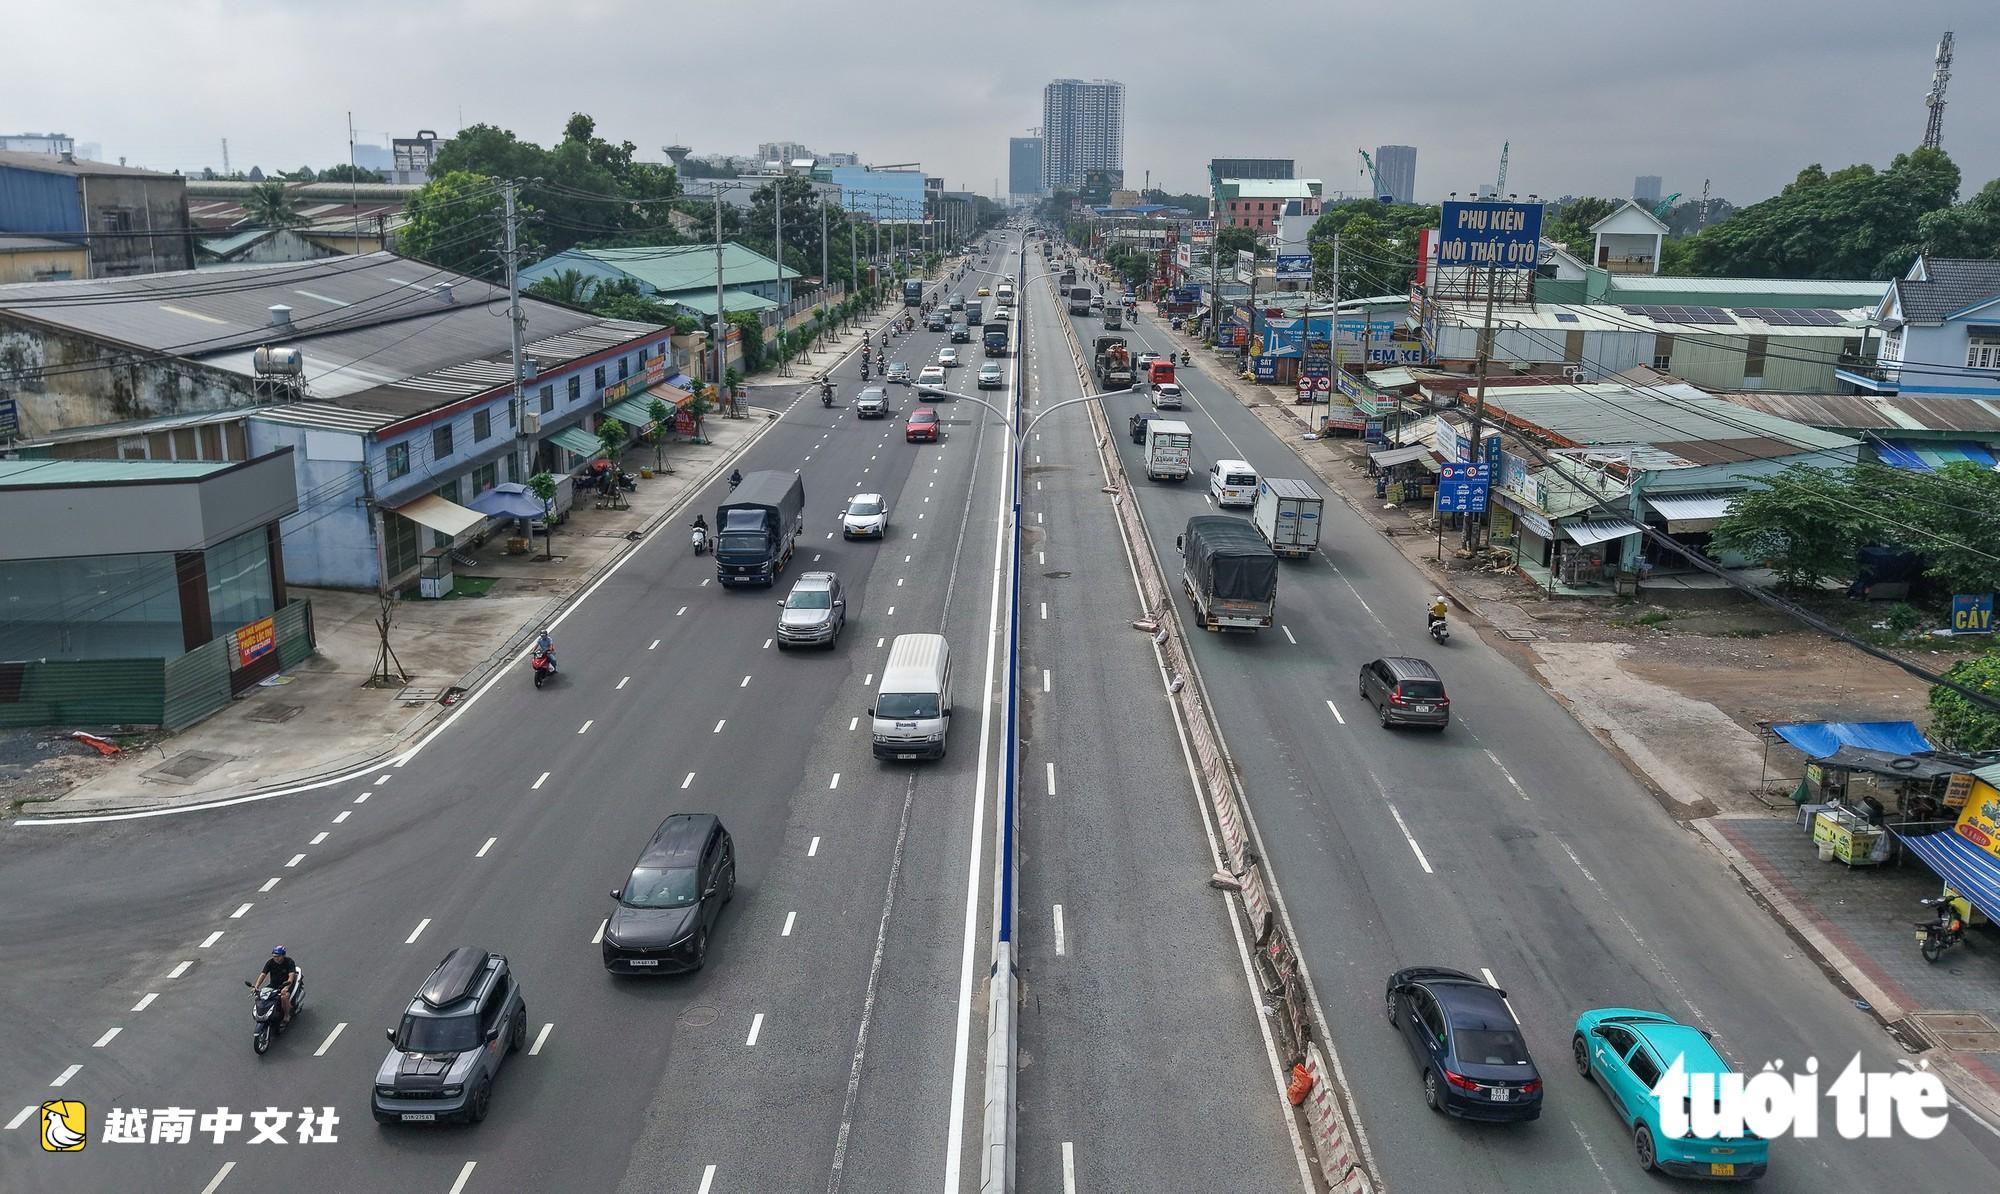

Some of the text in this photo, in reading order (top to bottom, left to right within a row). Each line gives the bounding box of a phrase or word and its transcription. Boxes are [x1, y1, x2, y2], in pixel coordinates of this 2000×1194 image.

[1458, 207, 1525, 234] PHỤ KIỆN
[1441, 236, 1536, 264] NỘI THẤT ÔTÔ
